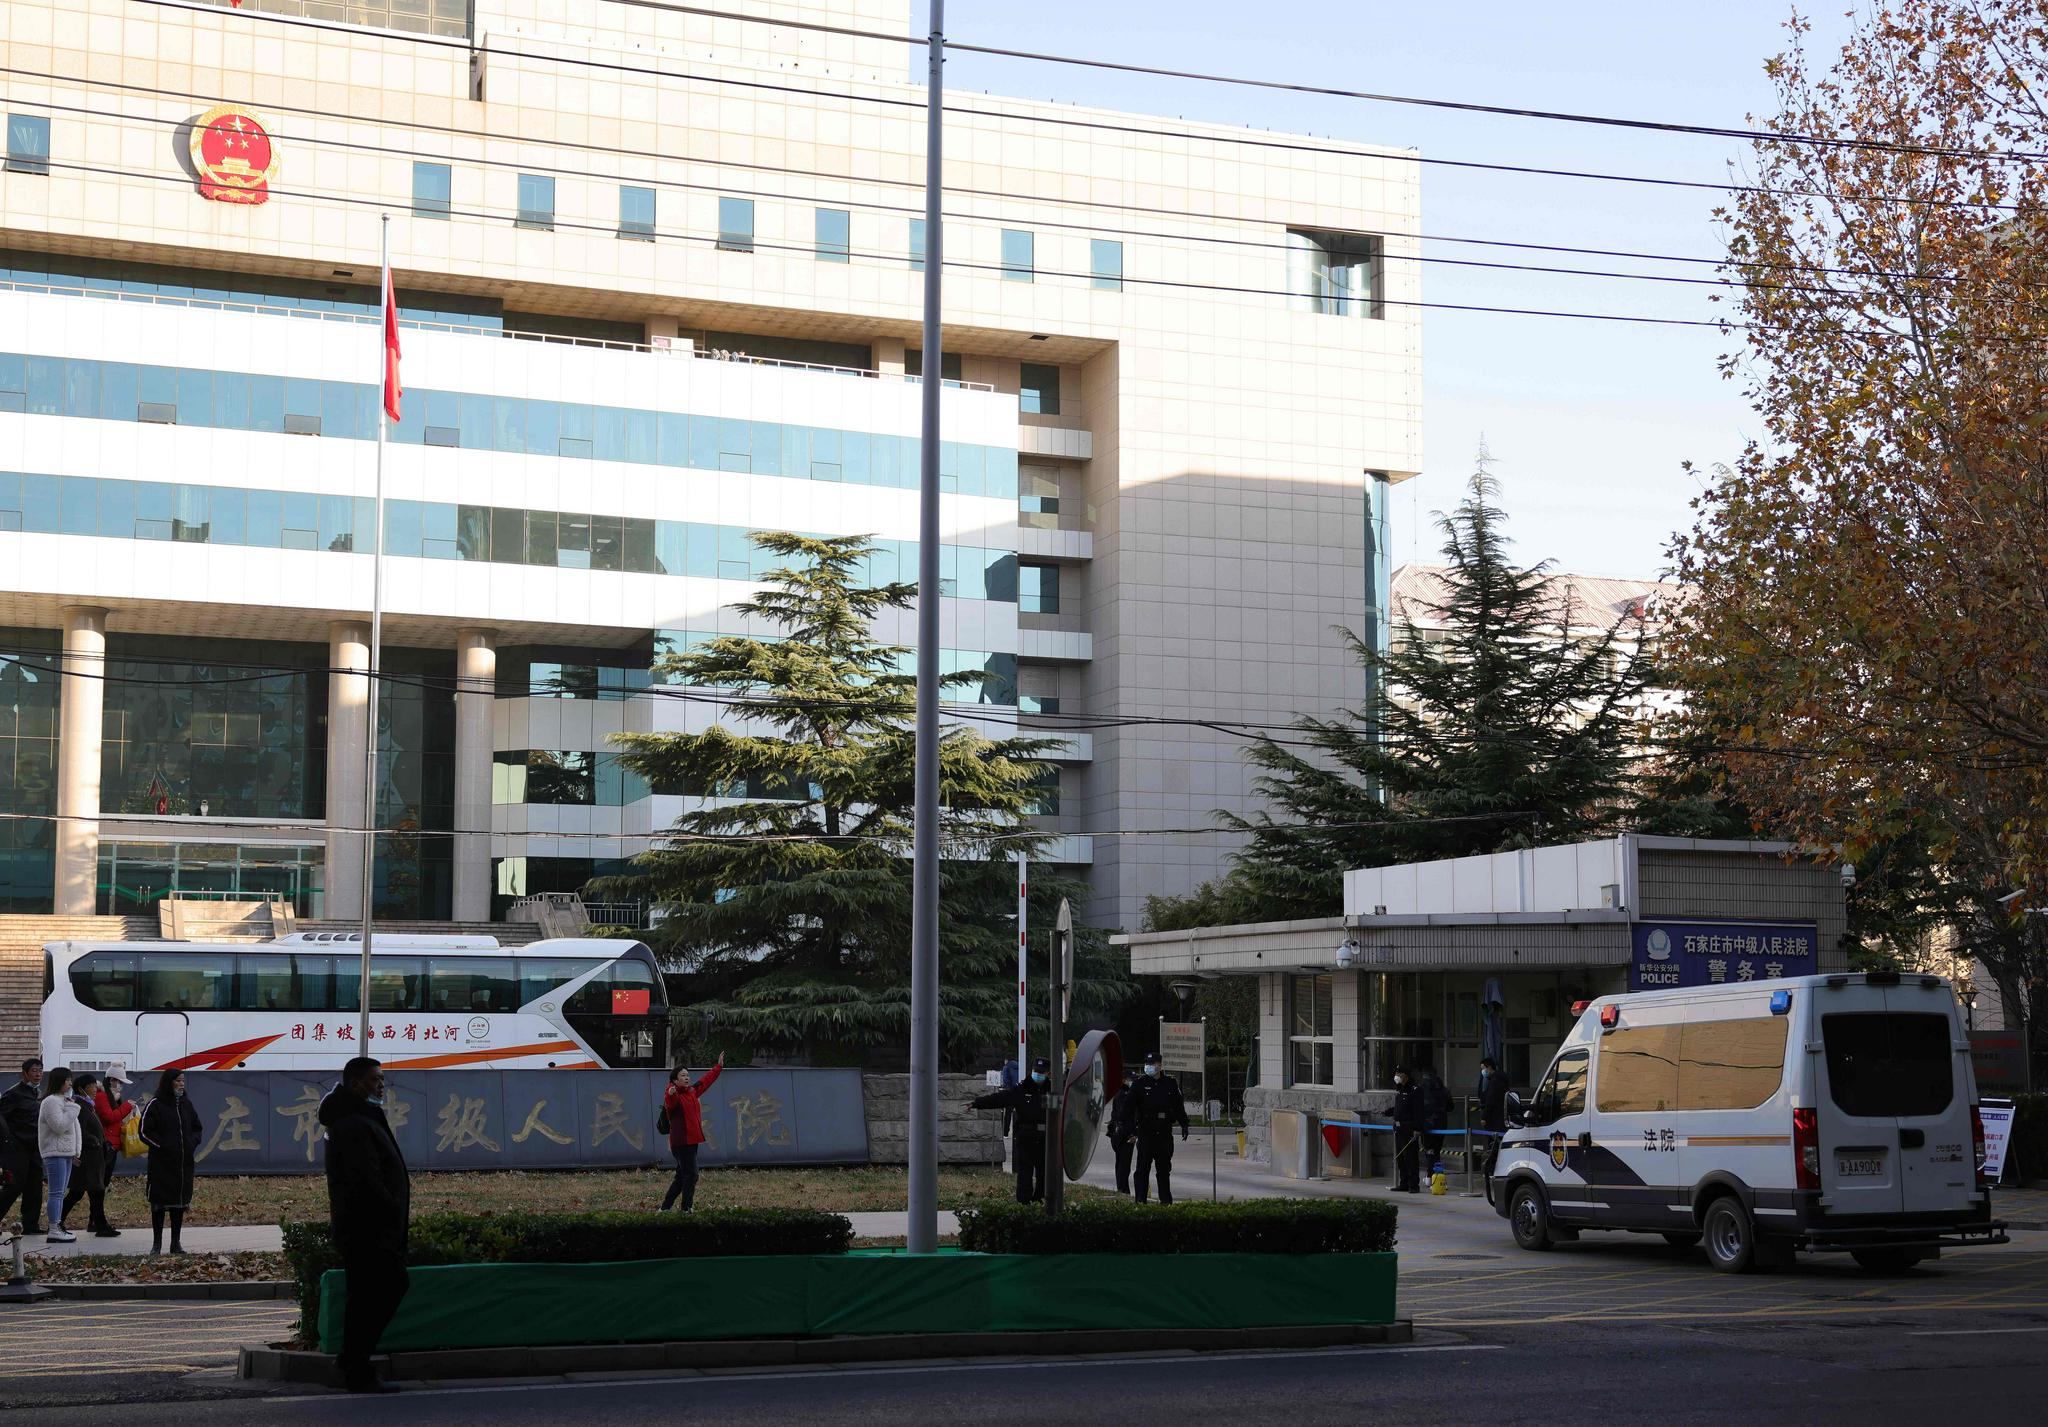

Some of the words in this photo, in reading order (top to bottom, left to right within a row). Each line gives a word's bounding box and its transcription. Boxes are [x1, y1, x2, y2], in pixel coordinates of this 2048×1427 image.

[1684, 935, 1808, 956] 石家庄市中级人民法院
[1639, 963, 1680, 972] 新华公安分局
[1708, 959, 1783, 982] 警务室
[1641, 973, 1679, 984] POLICE
[1644, 1128, 1675, 1152] 法院
